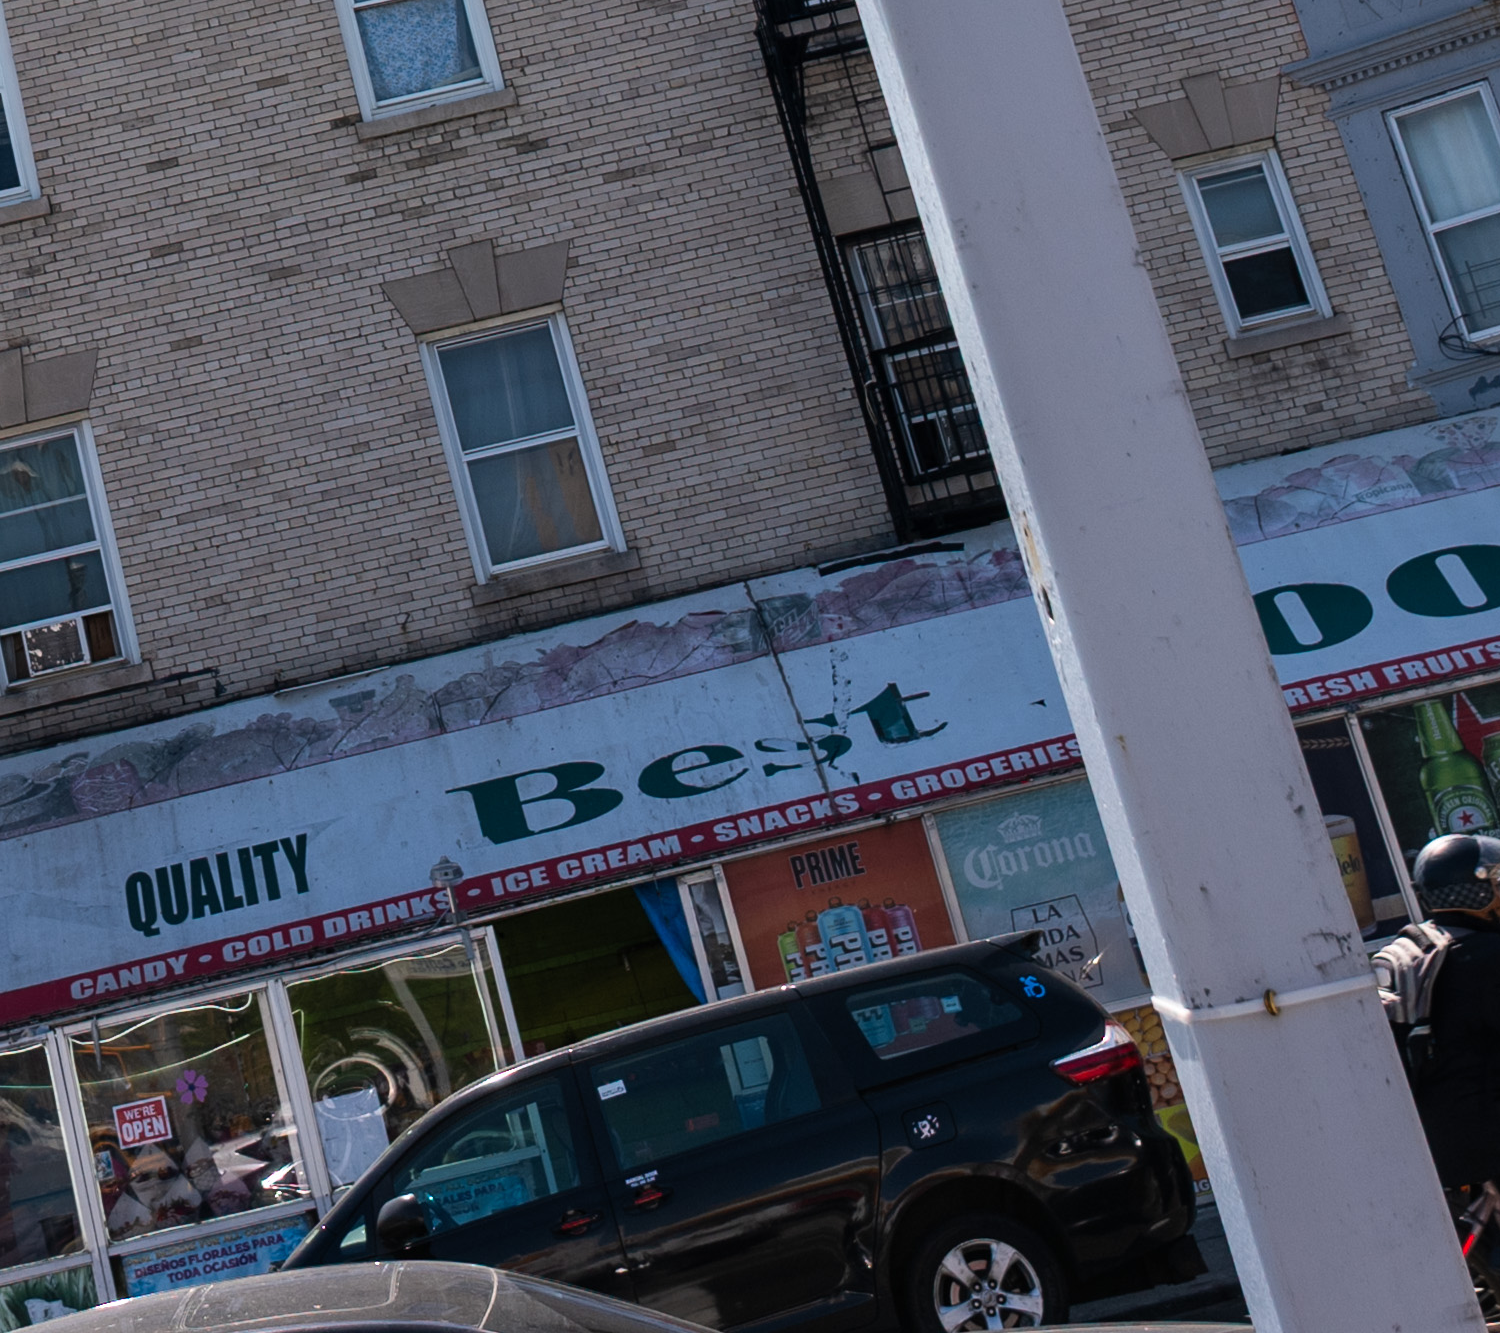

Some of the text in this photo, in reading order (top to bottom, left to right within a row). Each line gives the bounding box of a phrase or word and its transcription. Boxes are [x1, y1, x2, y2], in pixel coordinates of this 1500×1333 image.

[1284, 664, 1378, 707] RESH
[445, 681, 949, 846] Best
[70, 954, 189, 1001] CANDY
[222, 924, 315, 963] COLD
[322, 888, 454, 941] DRINKS
[490, 865, 551, 897] ICE
[556, 834, 682, 881] CREAM
[712, 791, 861, 845] SNACKS
[891, 737, 1084, 800] GROCERIES
[124, 833, 310, 938] QUALITY
[788, 840, 867, 889] PRIME
[963, 831, 1097, 891] Corona
[1031, 904, 1063, 924] LA
[121, 1116, 166, 1143] OPEN
[122, 1103, 158, 1120] WE'RE
[133, 1232, 286, 1281] DISEÑOS FLORALES PARA
[166, 1251, 259, 1284] TODA OCASIÓN
